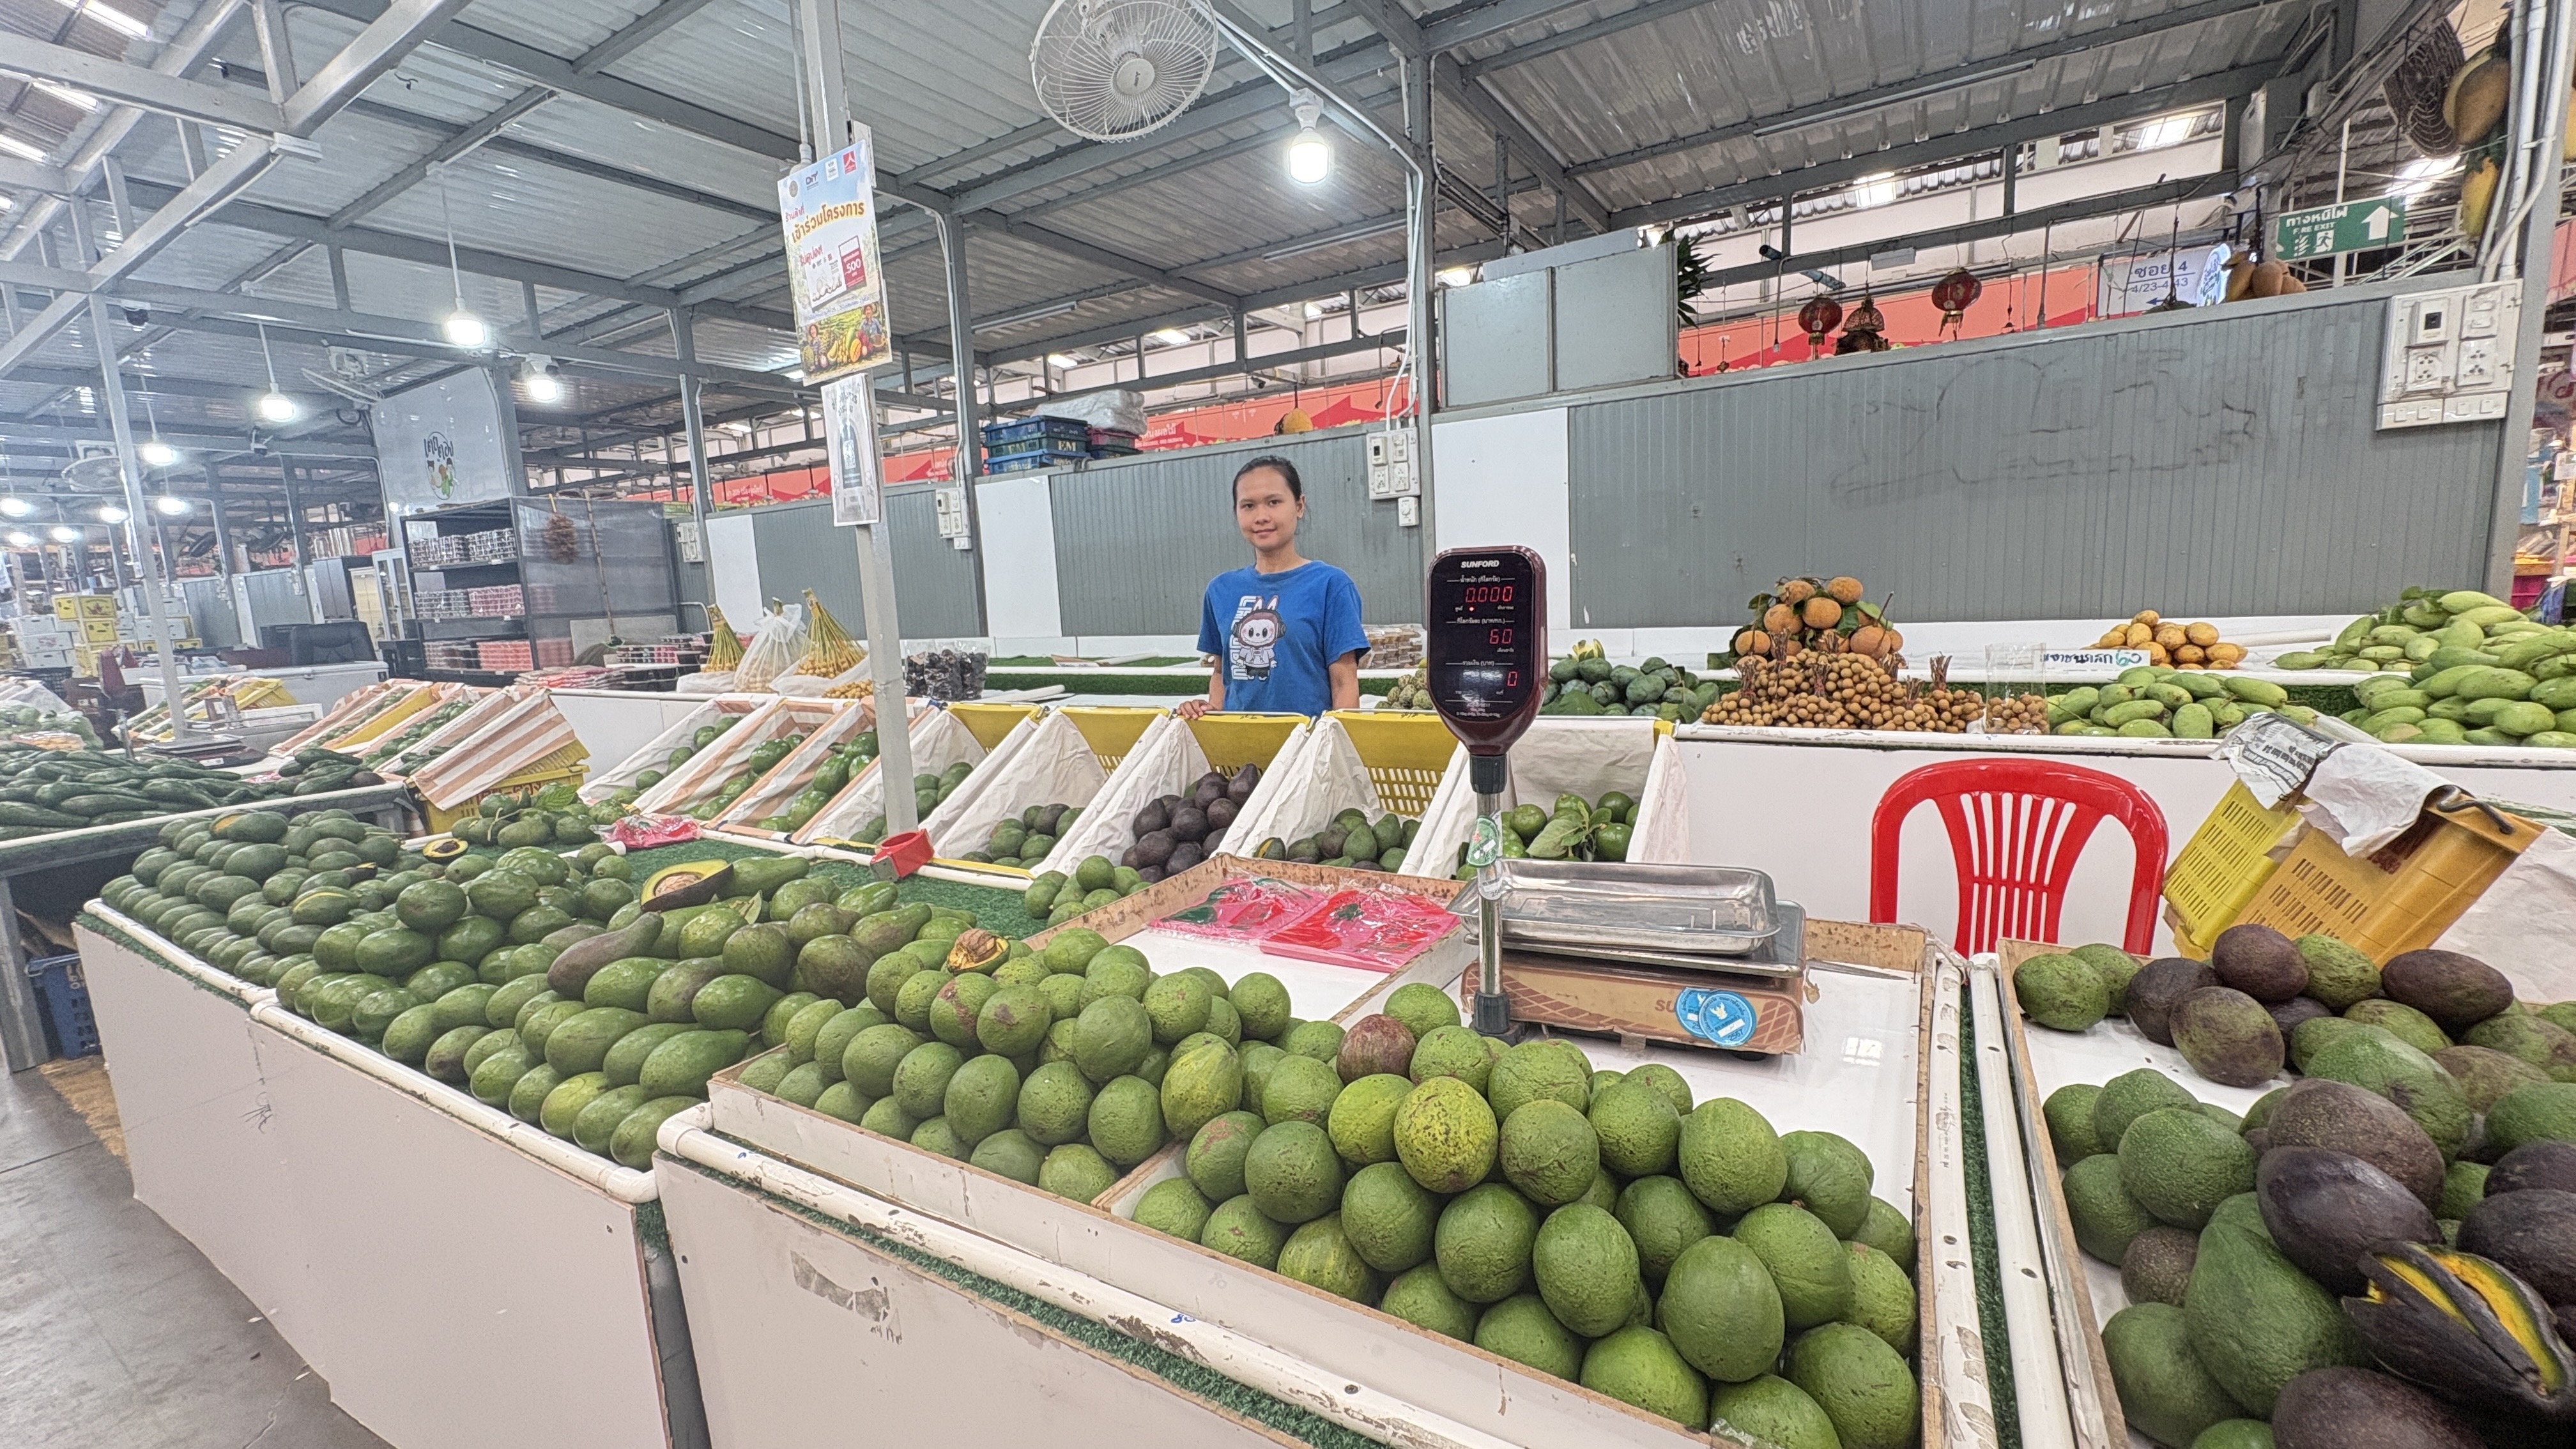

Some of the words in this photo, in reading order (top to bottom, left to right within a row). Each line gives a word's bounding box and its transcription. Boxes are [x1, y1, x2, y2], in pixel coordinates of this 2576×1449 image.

[792, 202, 864, 243] เข้าร่วมโครงการ
[2286, 206, 2348, 227] ทางหนีไฟ
[2313, 222, 2336, 231] EXIT
[846, 258, 861, 273] 500
[2135, 264, 2172, 278] ซอย
[2178, 261, 2188, 272] 4
[2131, 277, 2188, 293] 4/23-443
[1466, 586, 1514, 602] 0.000
[1489, 629, 1513, 644] 60
[1507, 671, 1517, 686] 0
